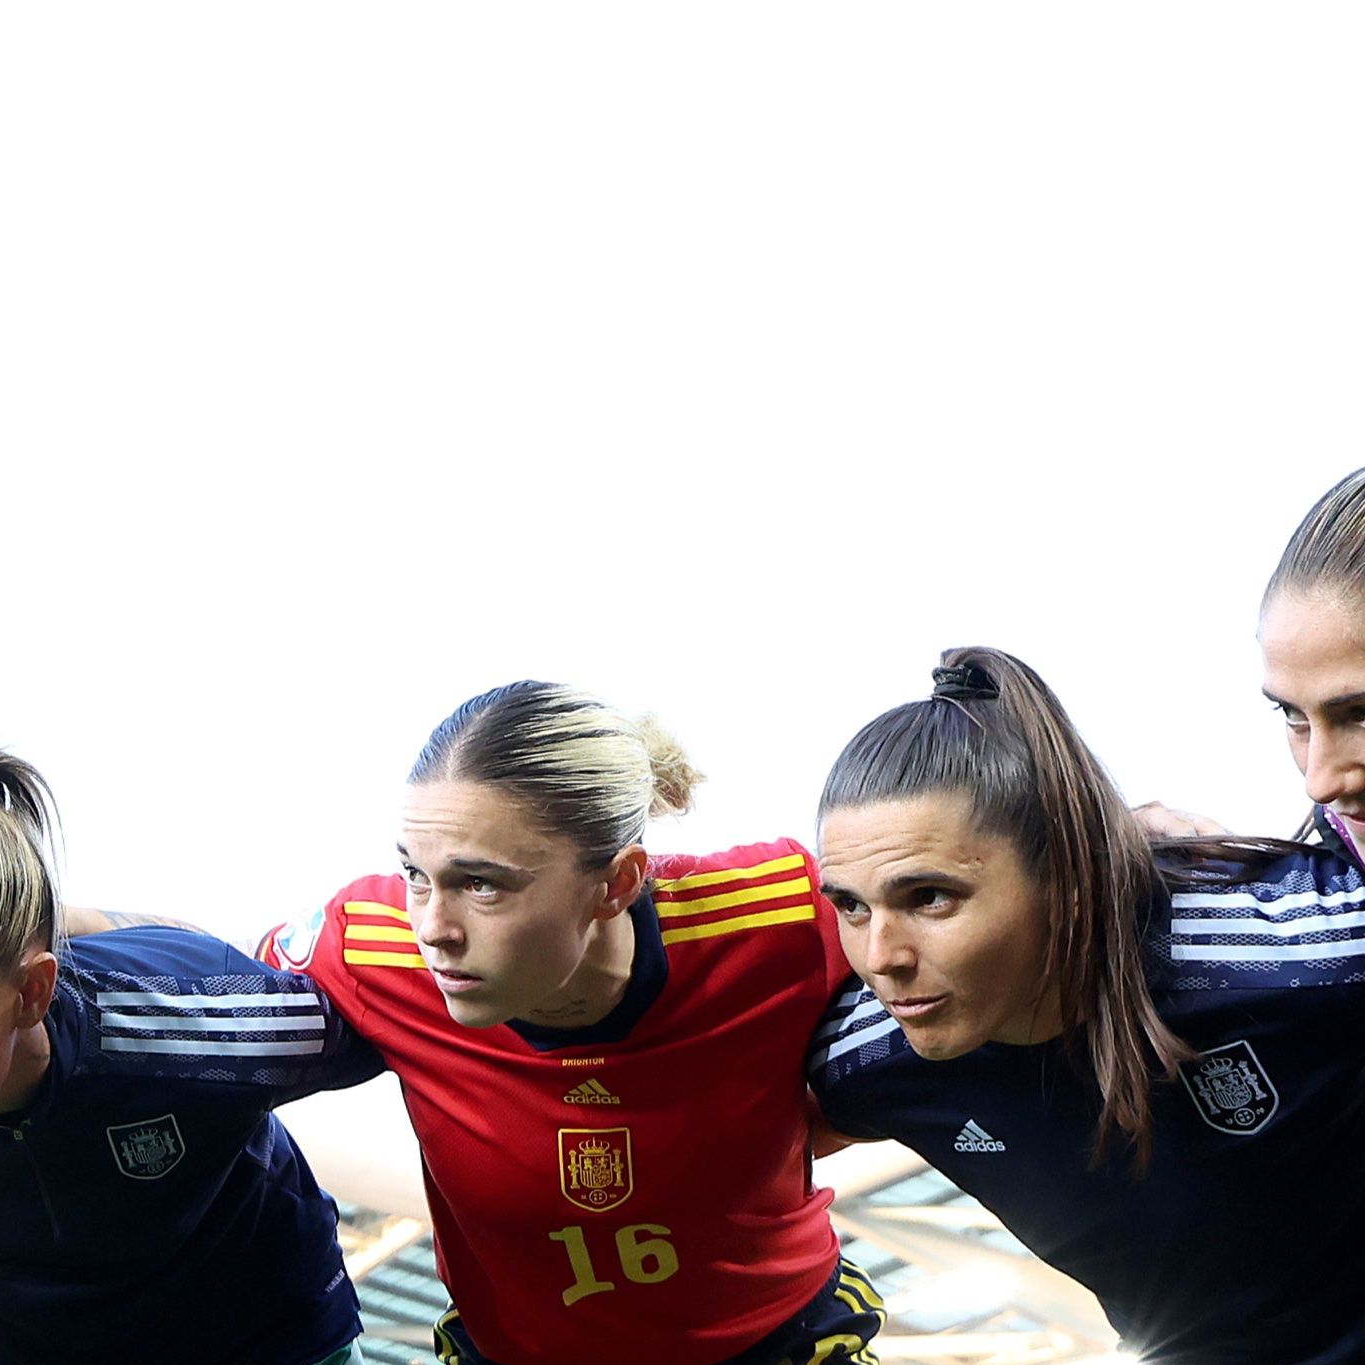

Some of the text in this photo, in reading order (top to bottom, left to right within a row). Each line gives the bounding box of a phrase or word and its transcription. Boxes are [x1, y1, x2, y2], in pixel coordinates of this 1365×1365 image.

[563, 1093, 621, 1105] adidas
[954, 1139, 1006, 1152] adidas
[548, 1223, 680, 1307] 16
